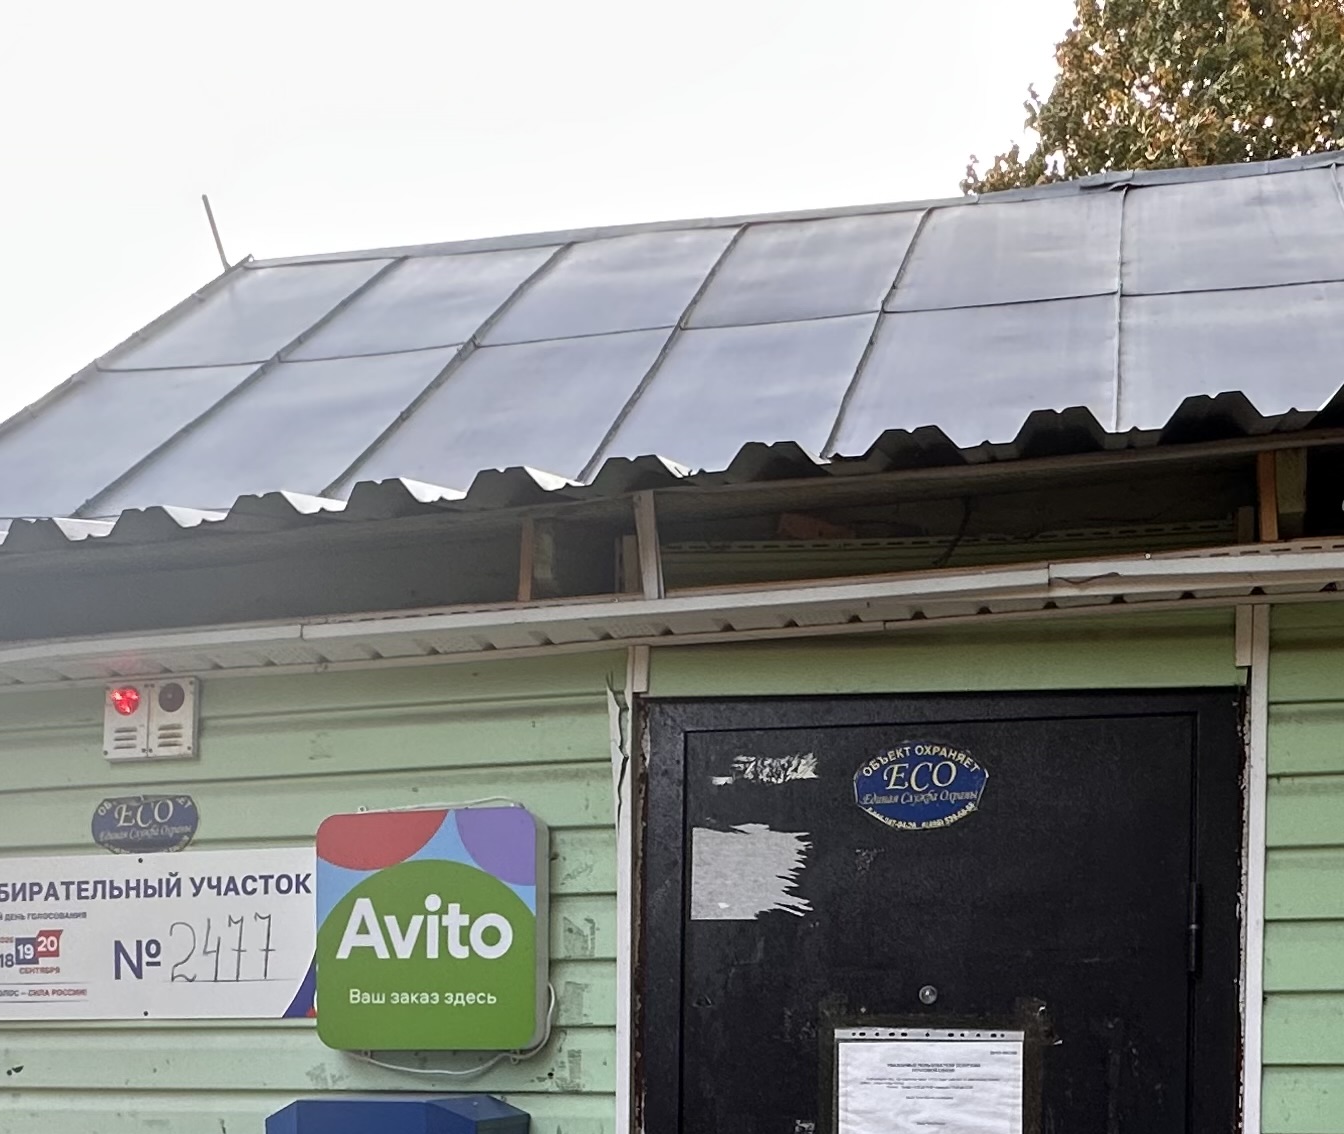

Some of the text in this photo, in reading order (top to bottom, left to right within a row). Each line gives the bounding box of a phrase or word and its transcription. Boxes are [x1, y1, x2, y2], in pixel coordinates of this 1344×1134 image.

[862, 745, 981, 777] ОБЪЕКТ ОХРАНЯЕТ
[900, 790, 938, 807] Служба
[939, 789, 978, 804] Охраны
[189, 873, 312, 898] УЧАСТОК
[4, 912, 26, 923] ДЕНЬ
[26, 911, 88, 921] ГОЛОСОВАНИЯ
[335, 893, 514, 960] Avito
[17, 943, 35, 960] 19
[37, 935, 58, 952] 20
[113, 912, 277, 982] № 2477
[19, 966, 61, 975] СЕНТЯБРЯ
[27, 988, 50, 998] СИЛА
[349, 988, 497, 1007] Ваш заказ здесь
